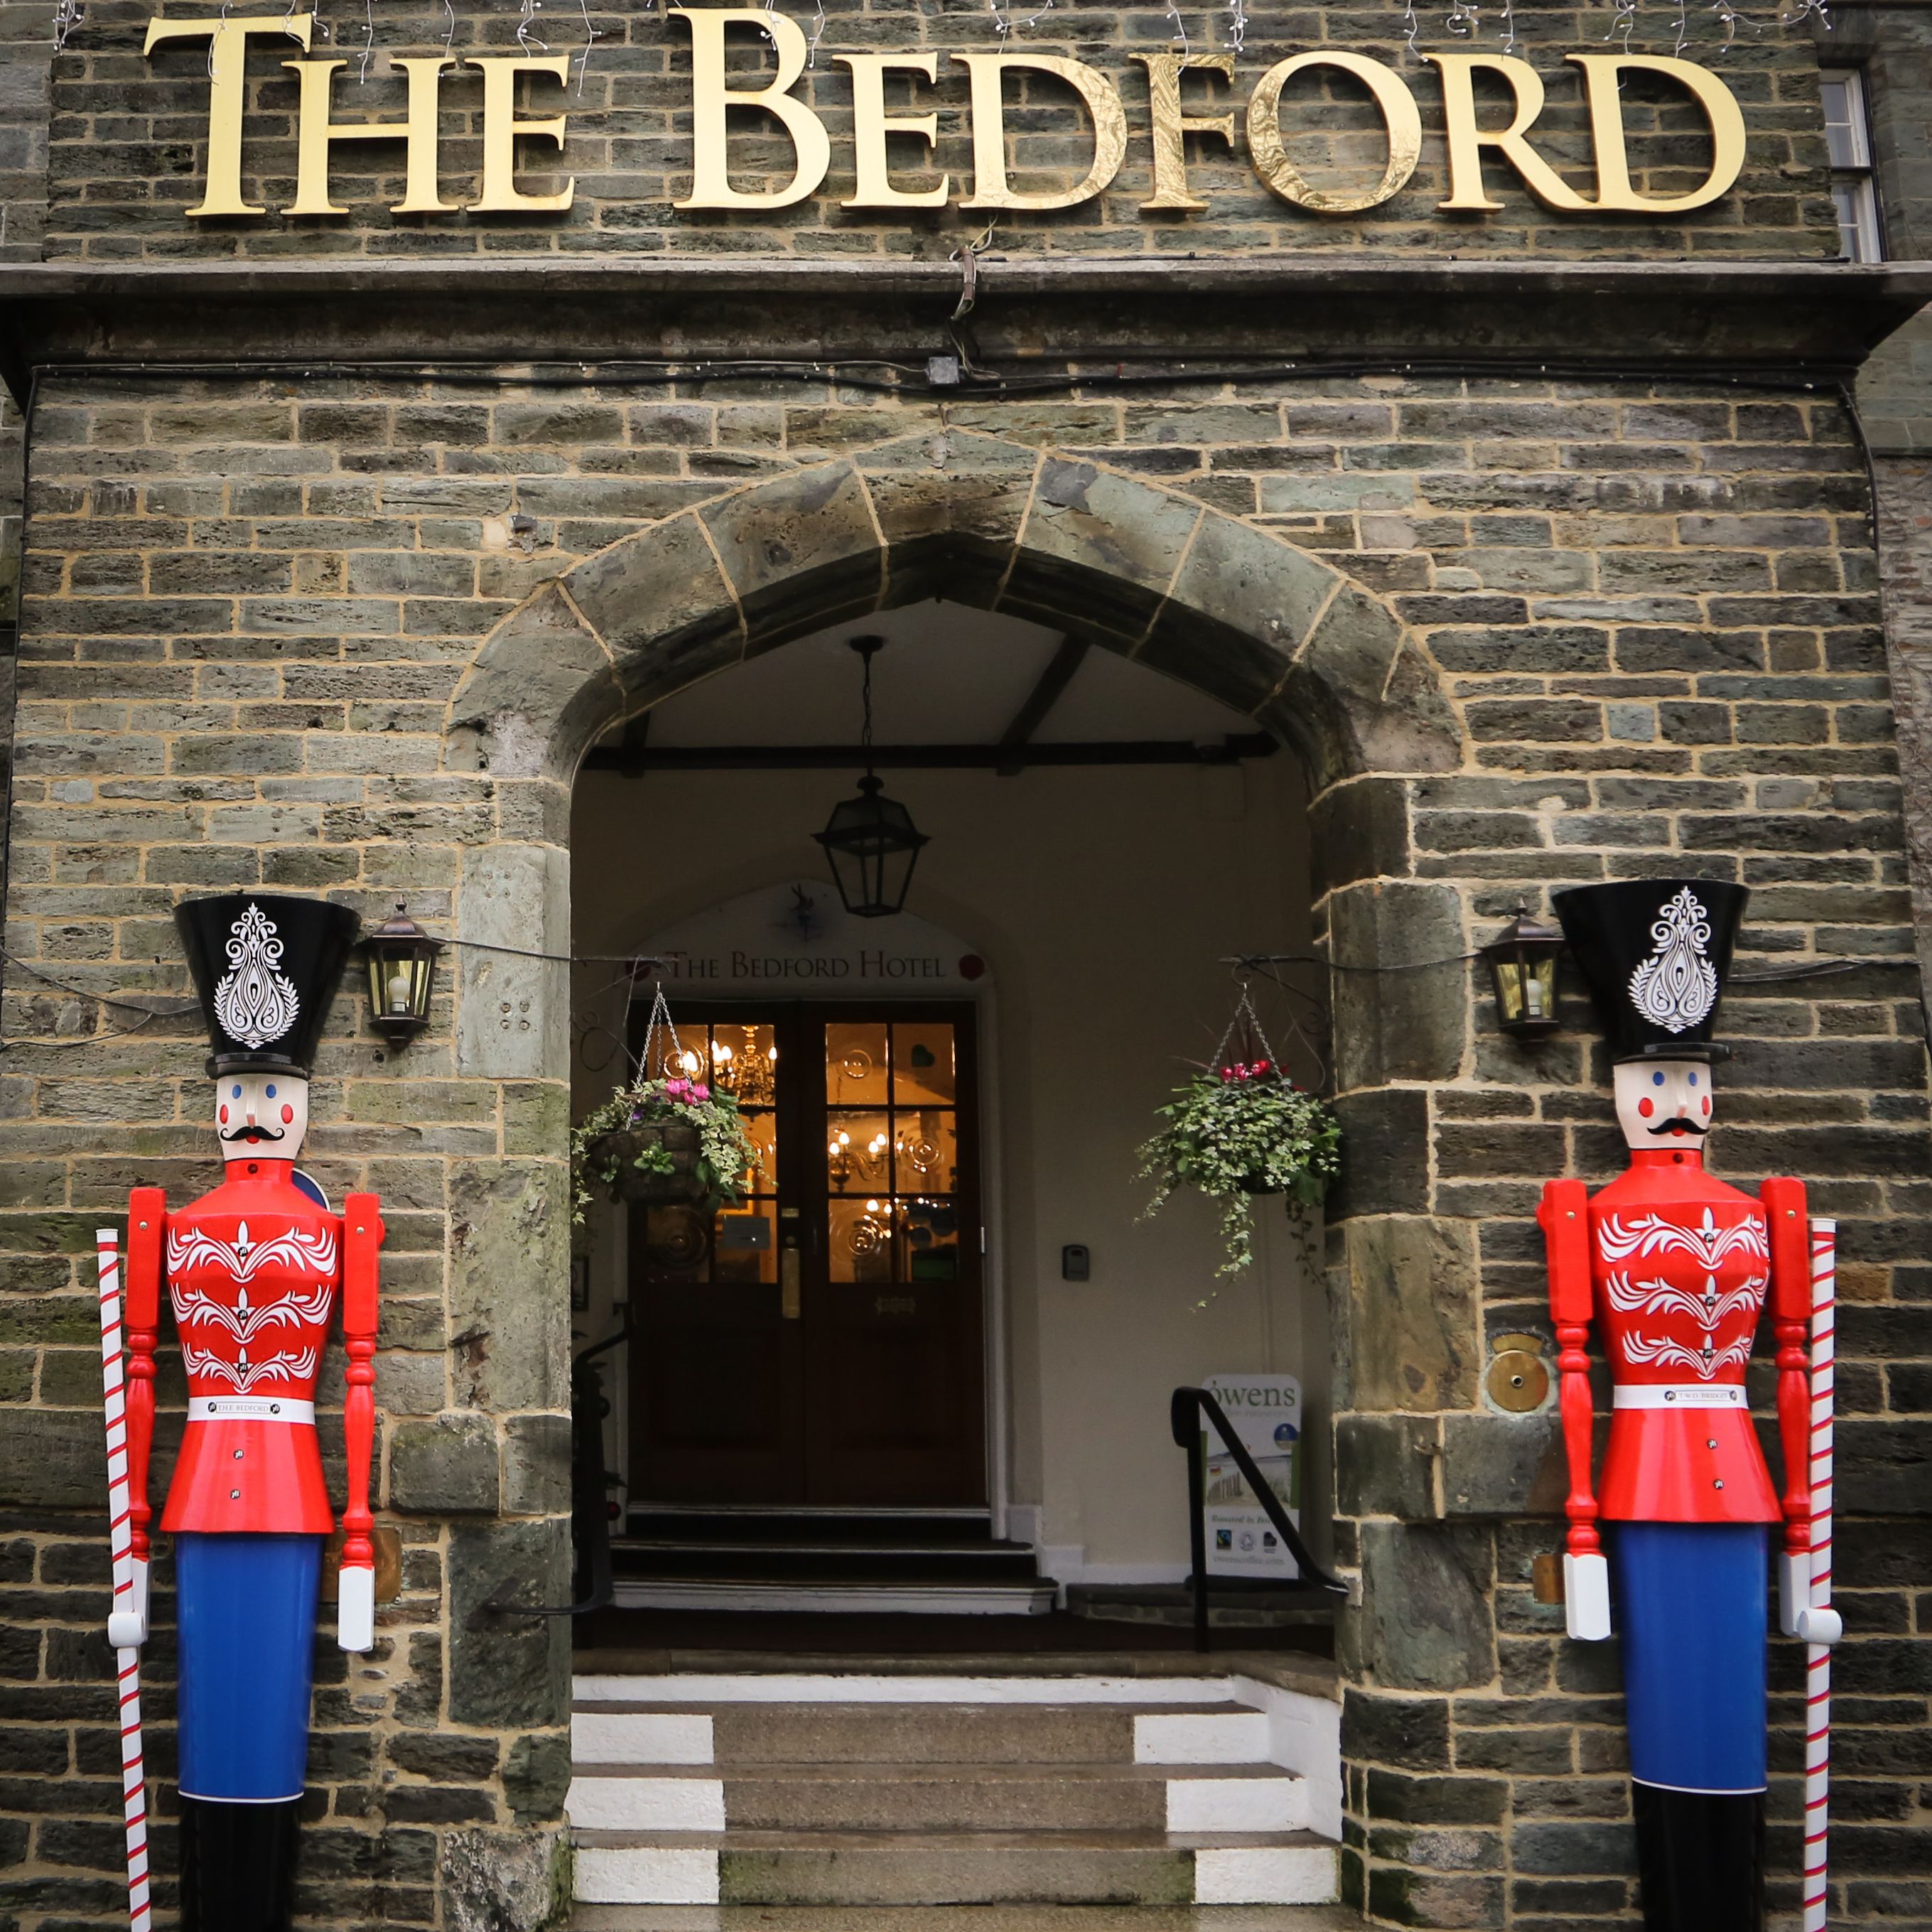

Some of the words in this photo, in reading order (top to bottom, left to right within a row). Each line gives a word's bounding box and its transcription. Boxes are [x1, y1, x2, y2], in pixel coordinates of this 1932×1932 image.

[143, 14, 574, 217] THE
[666, 6, 1747, 215] BEDFORD
[731, 950, 849, 978] BEDFORD
[860, 949, 946, 978] HOTEL
